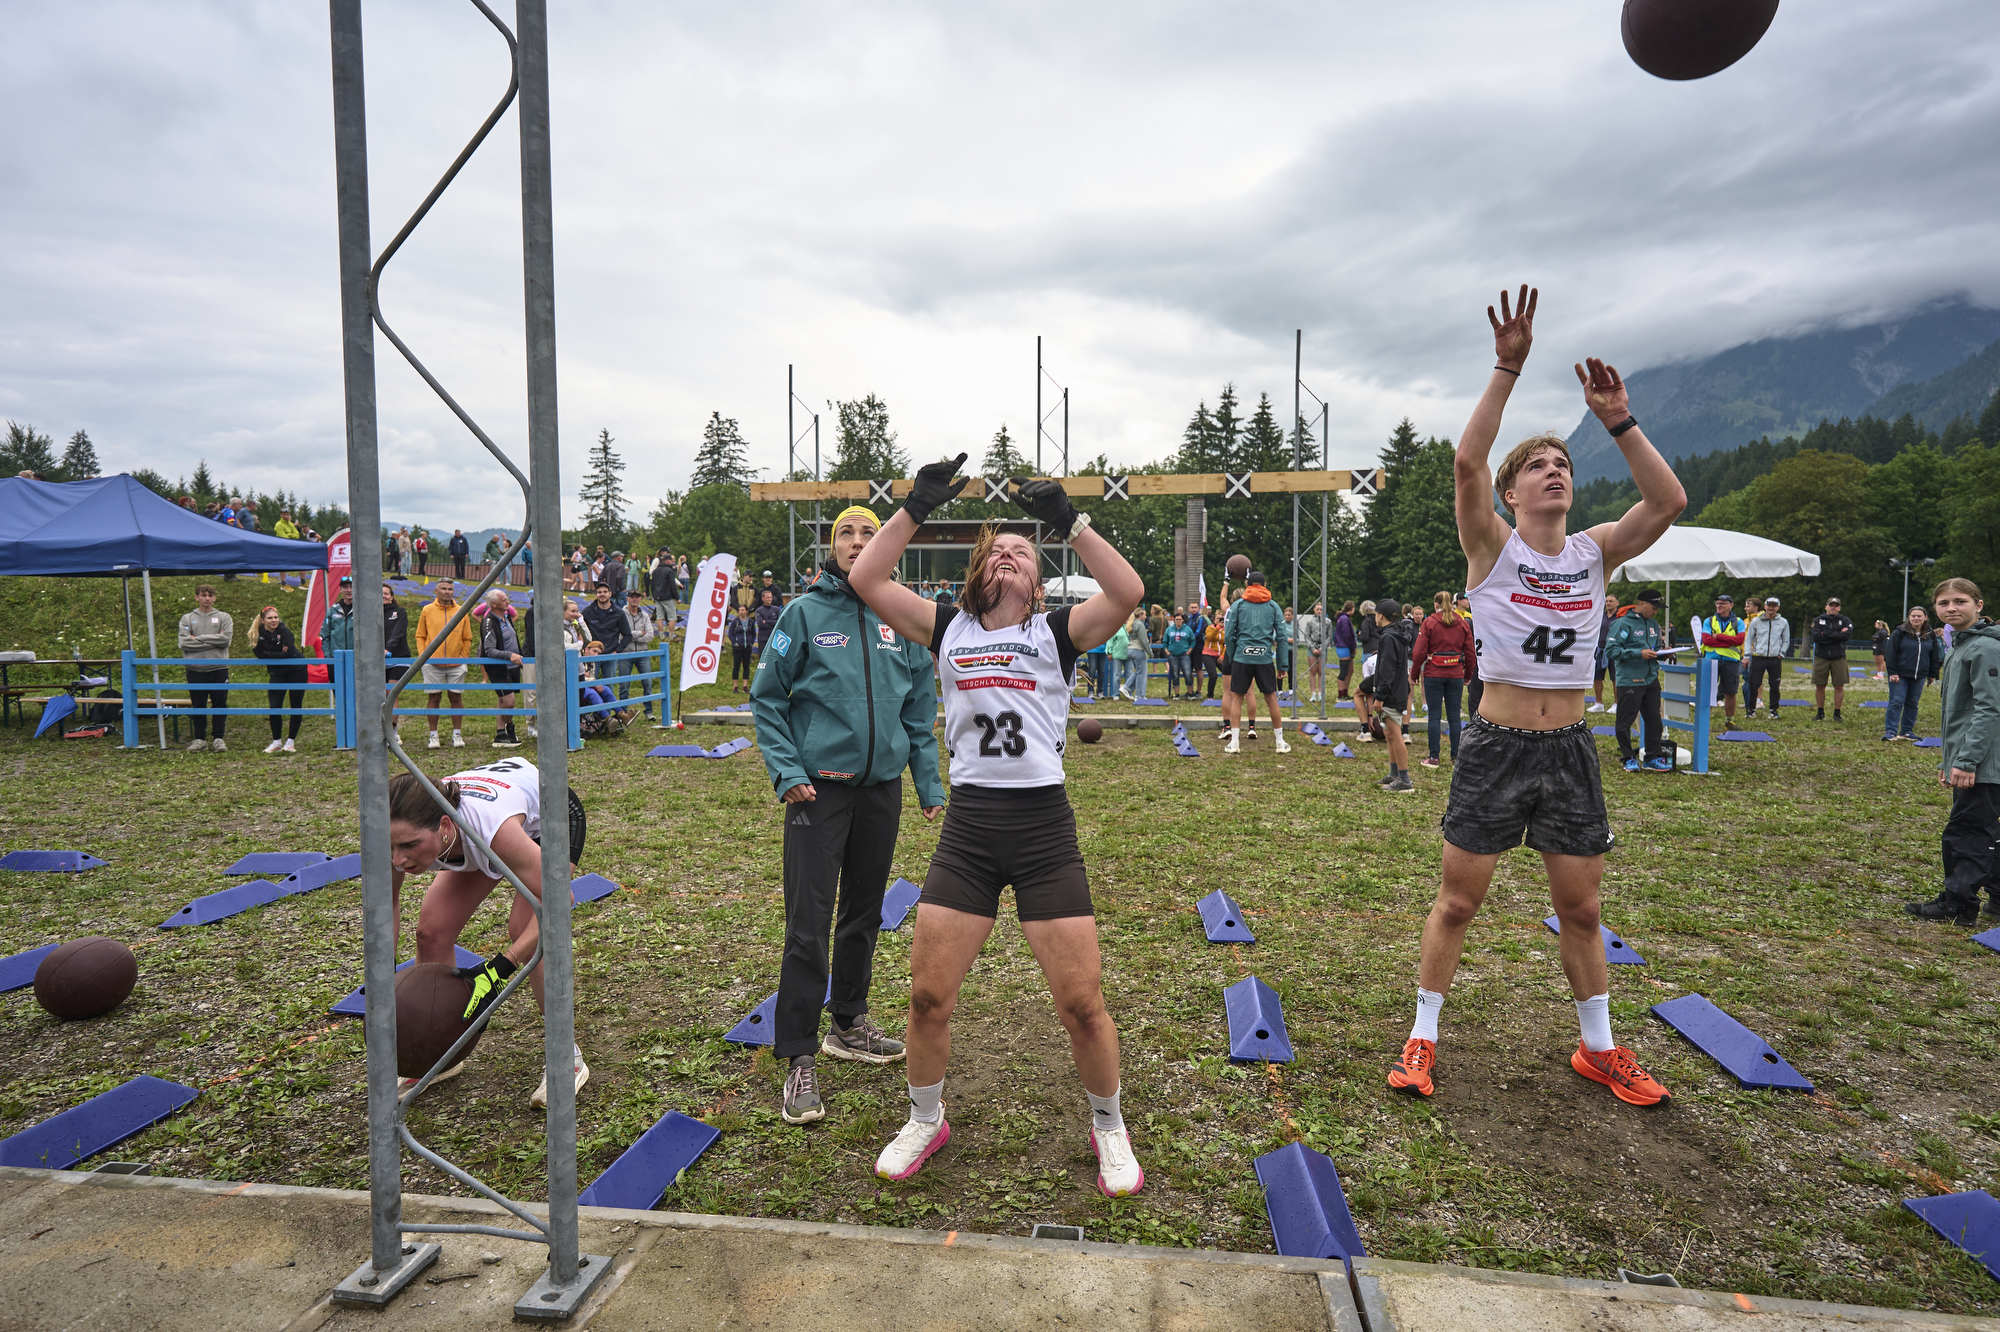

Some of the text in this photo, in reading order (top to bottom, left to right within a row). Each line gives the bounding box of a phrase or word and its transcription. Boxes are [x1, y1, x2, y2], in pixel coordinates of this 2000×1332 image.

[705, 571, 728, 644] TOGU
[1243, 645, 1267, 656] GER
[1521, 625, 1577, 664] 42
[972, 711, 1028, 758] 23
